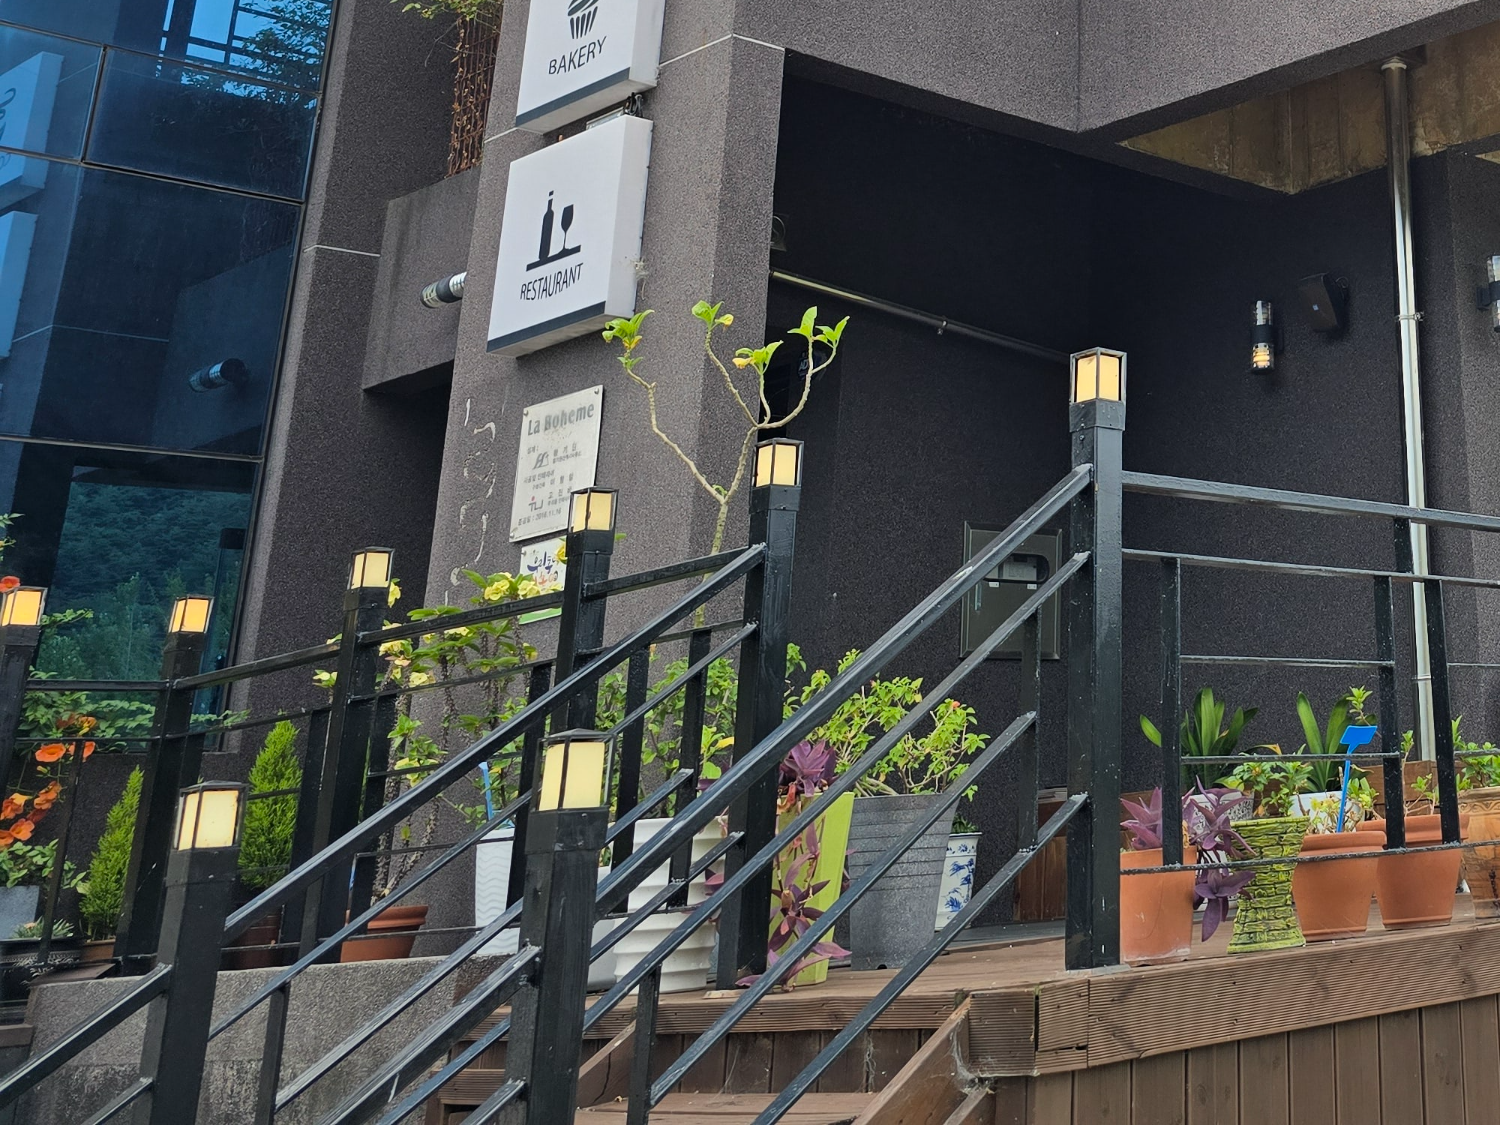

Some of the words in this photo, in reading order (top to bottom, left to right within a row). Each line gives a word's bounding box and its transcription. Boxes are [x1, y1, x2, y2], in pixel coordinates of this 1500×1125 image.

[548, 35, 607, 75] BAKERY
[520, 262, 584, 301] RESTAURANT
[528, 420, 541, 436] La
[543, 403, 595, 432] Boheme
